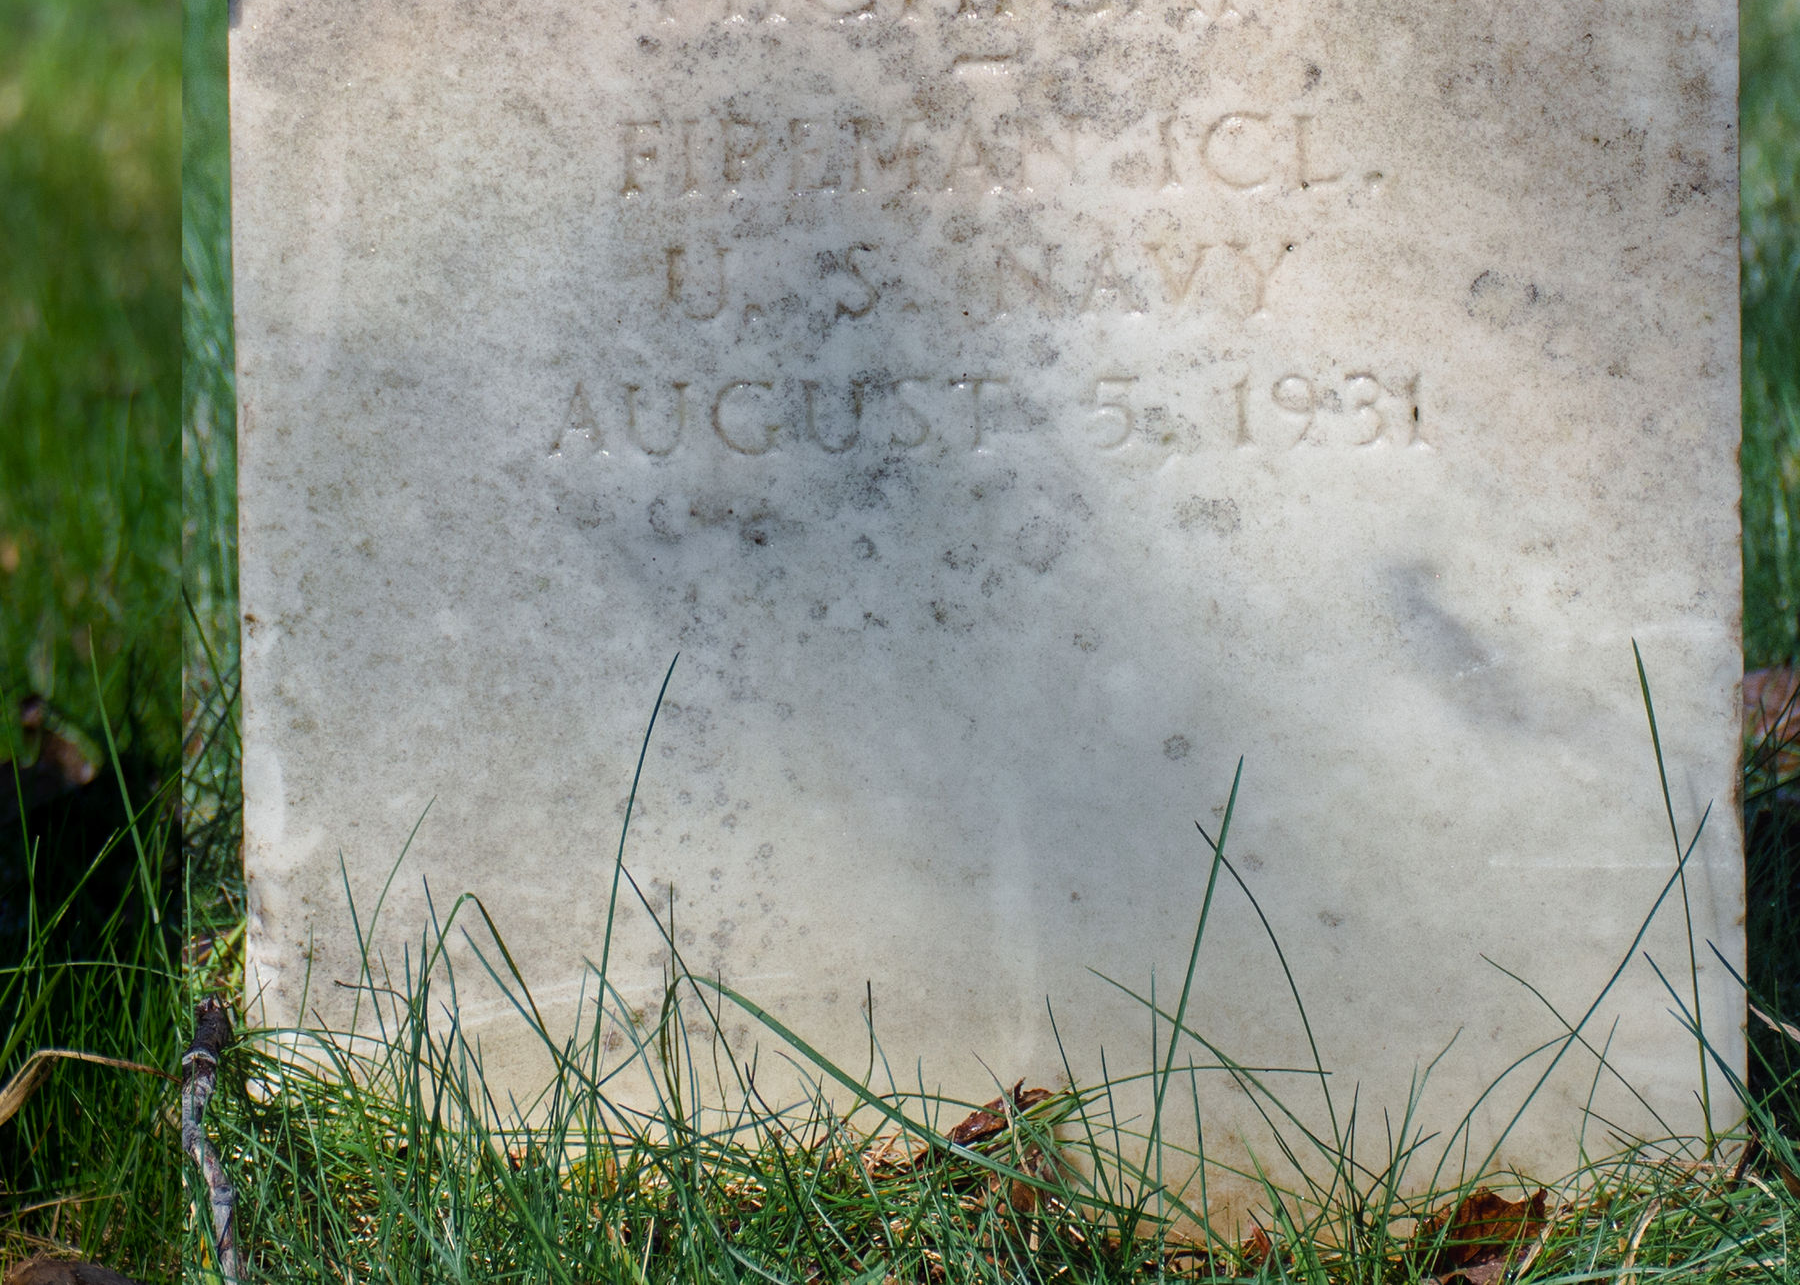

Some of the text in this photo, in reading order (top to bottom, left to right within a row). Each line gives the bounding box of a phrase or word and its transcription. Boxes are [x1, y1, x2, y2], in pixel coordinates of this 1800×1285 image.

[990, 241, 1302, 318] NAVY
[546, 378, 1012, 460] AUGUST
[1230, 368, 1442, 454] 1931
